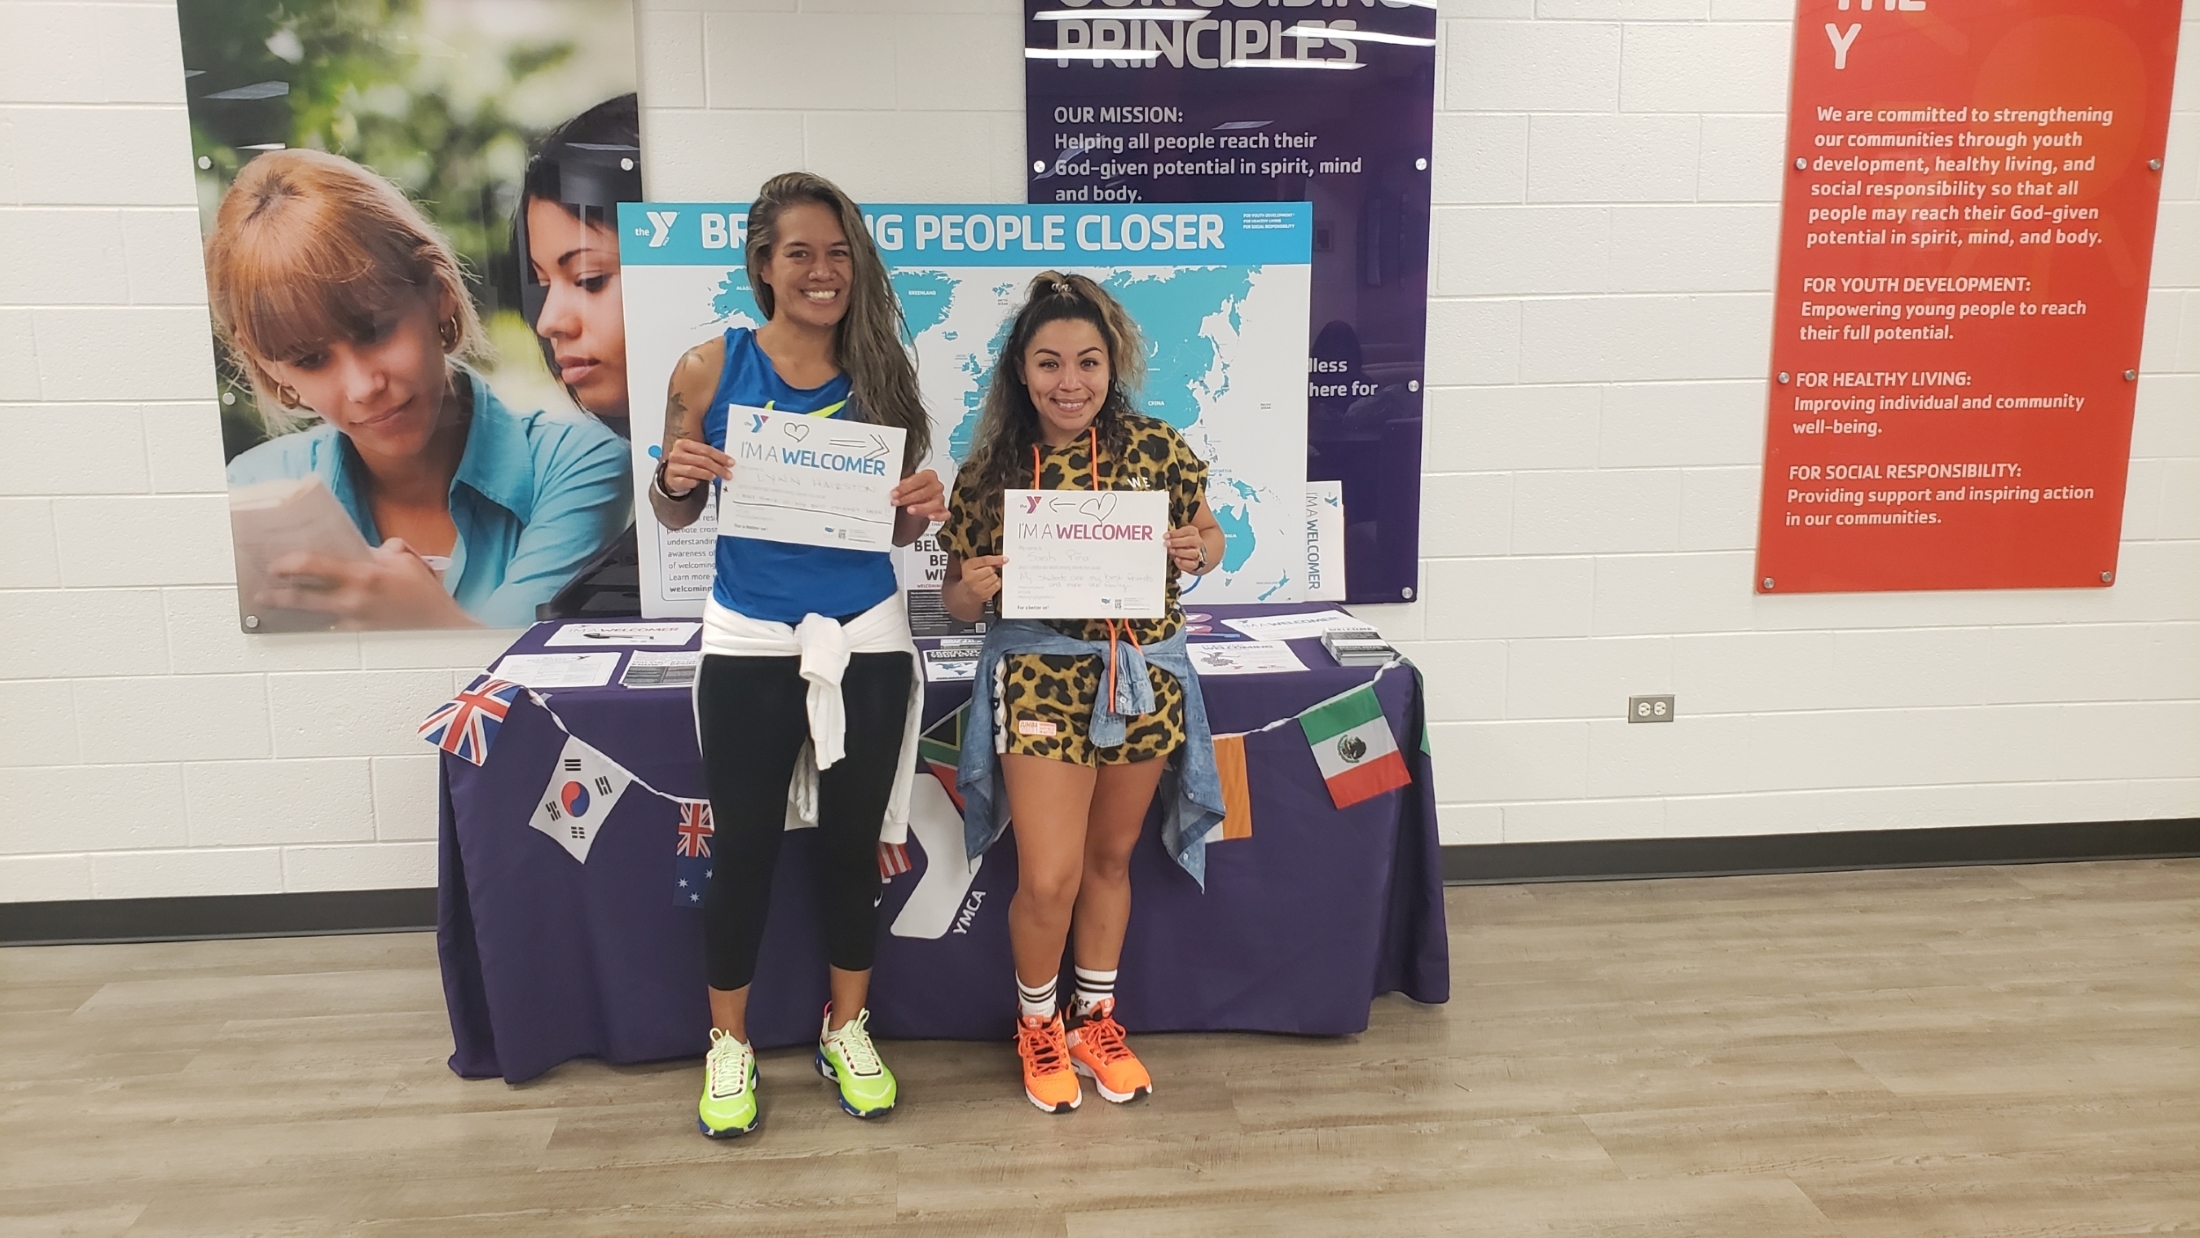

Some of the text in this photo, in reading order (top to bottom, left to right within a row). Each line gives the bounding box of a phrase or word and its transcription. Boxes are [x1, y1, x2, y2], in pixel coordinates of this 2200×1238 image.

[1057, 19, 1358, 69] PRINCIPLES
[1825, 24, 1861, 69] Y
[1055, 107, 1182, 123] OUR MISSION:
[1818, 107, 2112, 126] We are committed to strengthening
[1055, 133, 1317, 153] Helping all people reach their
[1815, 132, 2082, 150] our communities through youth
[1055, 157, 1362, 180] God-given potential in spirit, mind
[1813, 156, 2095, 175] development, healthy living, and
[1056, 184, 1142, 203] and body.
[1812, 181, 2078, 199] social responsibility so that all
[1809, 205, 2098, 223] people may reach their God-given
[634, 228, 650, 236] the
[916, 214, 1065, 250] PEOPLE
[1076, 214, 1225, 250] CLOSER
[1807, 229, 2101, 248] potential in spirit, mind, and body.
[1804, 278, 2030, 292] FOR YOUTH DEVELOPMENT:
[1802, 300, 2086, 320] Empowering young people to reach
[1800, 325, 1953, 343] their full potential.
[1309, 380, 1378, 397] here for
[1797, 372, 1971, 387] FOR HEALTHY LIVING:
[1795, 394, 2084, 414] Improving individual and community
[1793, 419, 1882, 437] well-being.
[741, 441, 886, 476] I'M A WELCOMER
[1790, 464, 2021, 480] FOR SOCIAL RESPONSIBILITY:
[1127, 476, 1151, 488] WE
[1788, 485, 2093, 506] Providing support and inspiring action
[1306, 509, 1318, 518] A
[1786, 510, 1941, 525] in our communities.
[1018, 523, 1153, 540] I'M A WELCOMER
[1028, 551, 1056, 561] Sarah
[1307, 519, 1321, 590] WELCOMER
[1270, 616, 1339, 626] WELCOMER
[952, 890, 986, 934] YMCA
